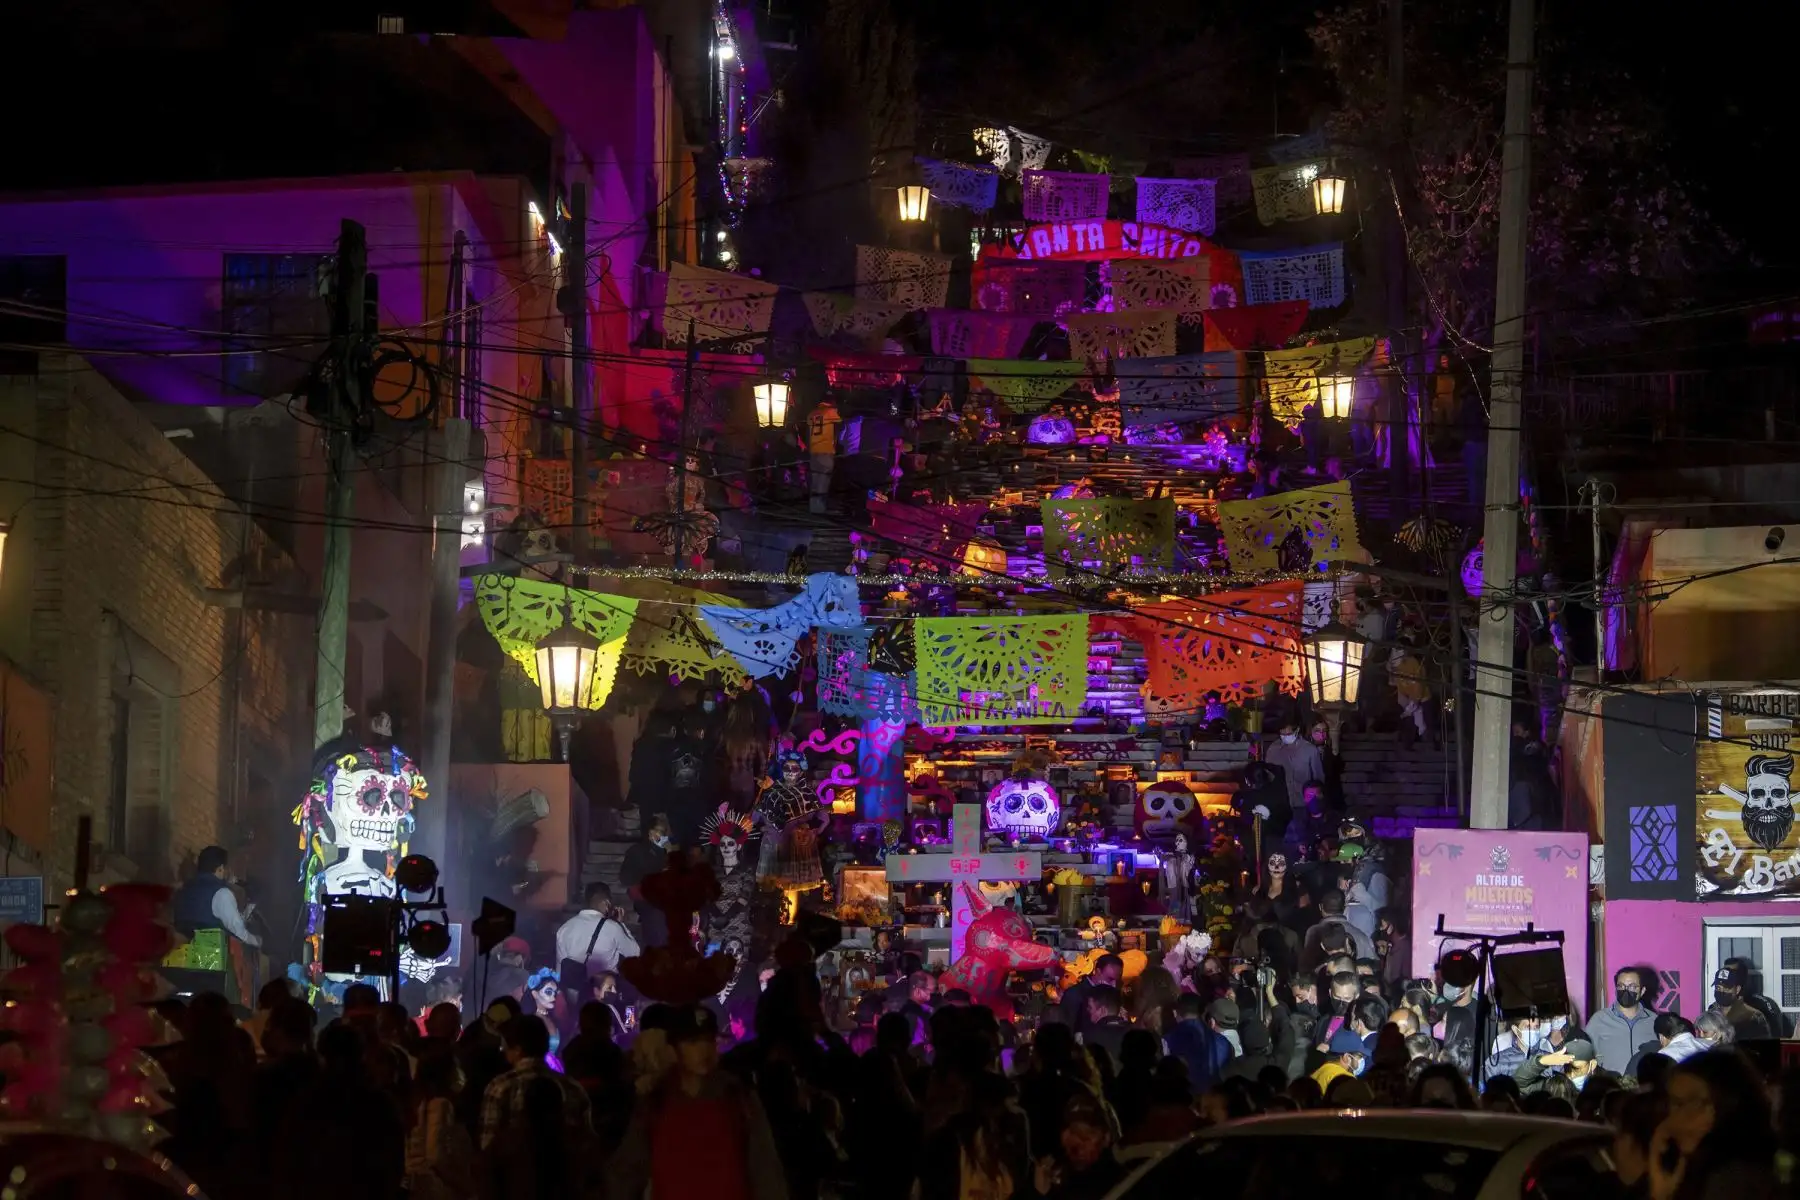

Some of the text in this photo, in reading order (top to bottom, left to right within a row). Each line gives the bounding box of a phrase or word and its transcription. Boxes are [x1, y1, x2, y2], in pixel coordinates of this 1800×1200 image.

[1013, 223, 1201, 259] SANTA ANITA
[1730, 694, 1800, 716] BARBE
[1750, 733, 1790, 751] SHOP
[1476, 875, 1524, 886] ALTAR DE
[1465, 887, 1533, 903] MUERTOS
